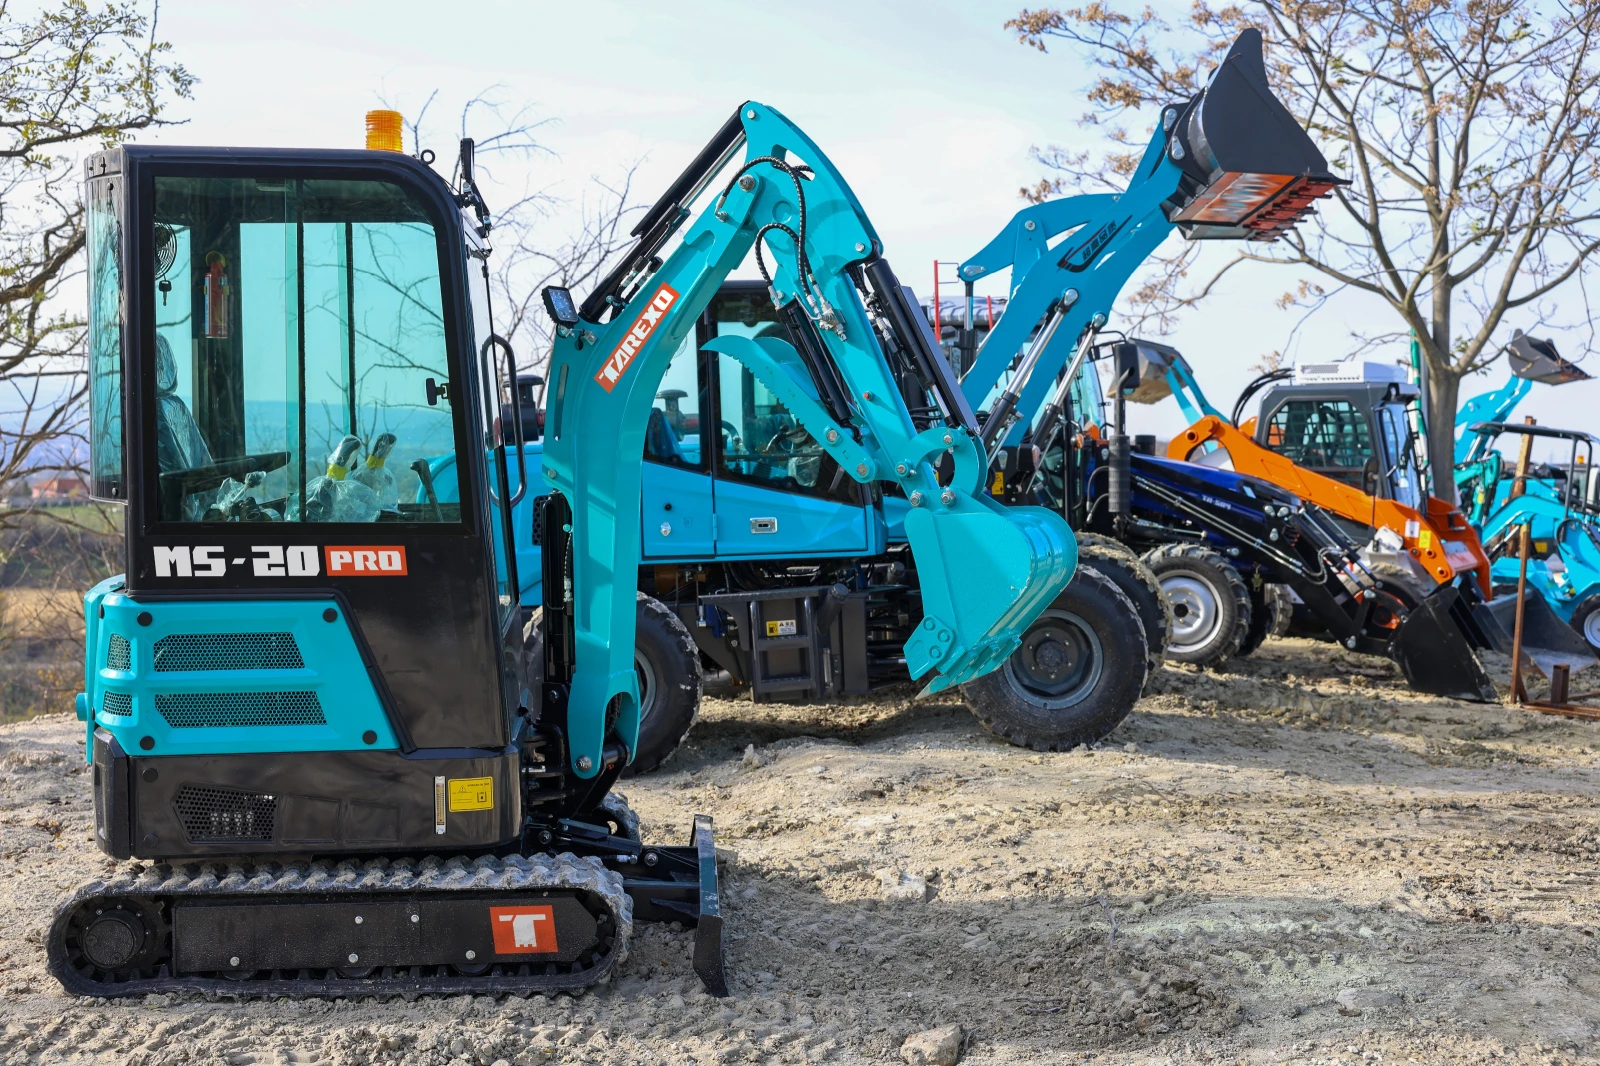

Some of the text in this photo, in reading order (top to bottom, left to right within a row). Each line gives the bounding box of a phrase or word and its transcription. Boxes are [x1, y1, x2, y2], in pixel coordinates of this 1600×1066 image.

[598, 289, 674, 383] TAREXO
[153, 545, 403, 577] MS-20 PRO
